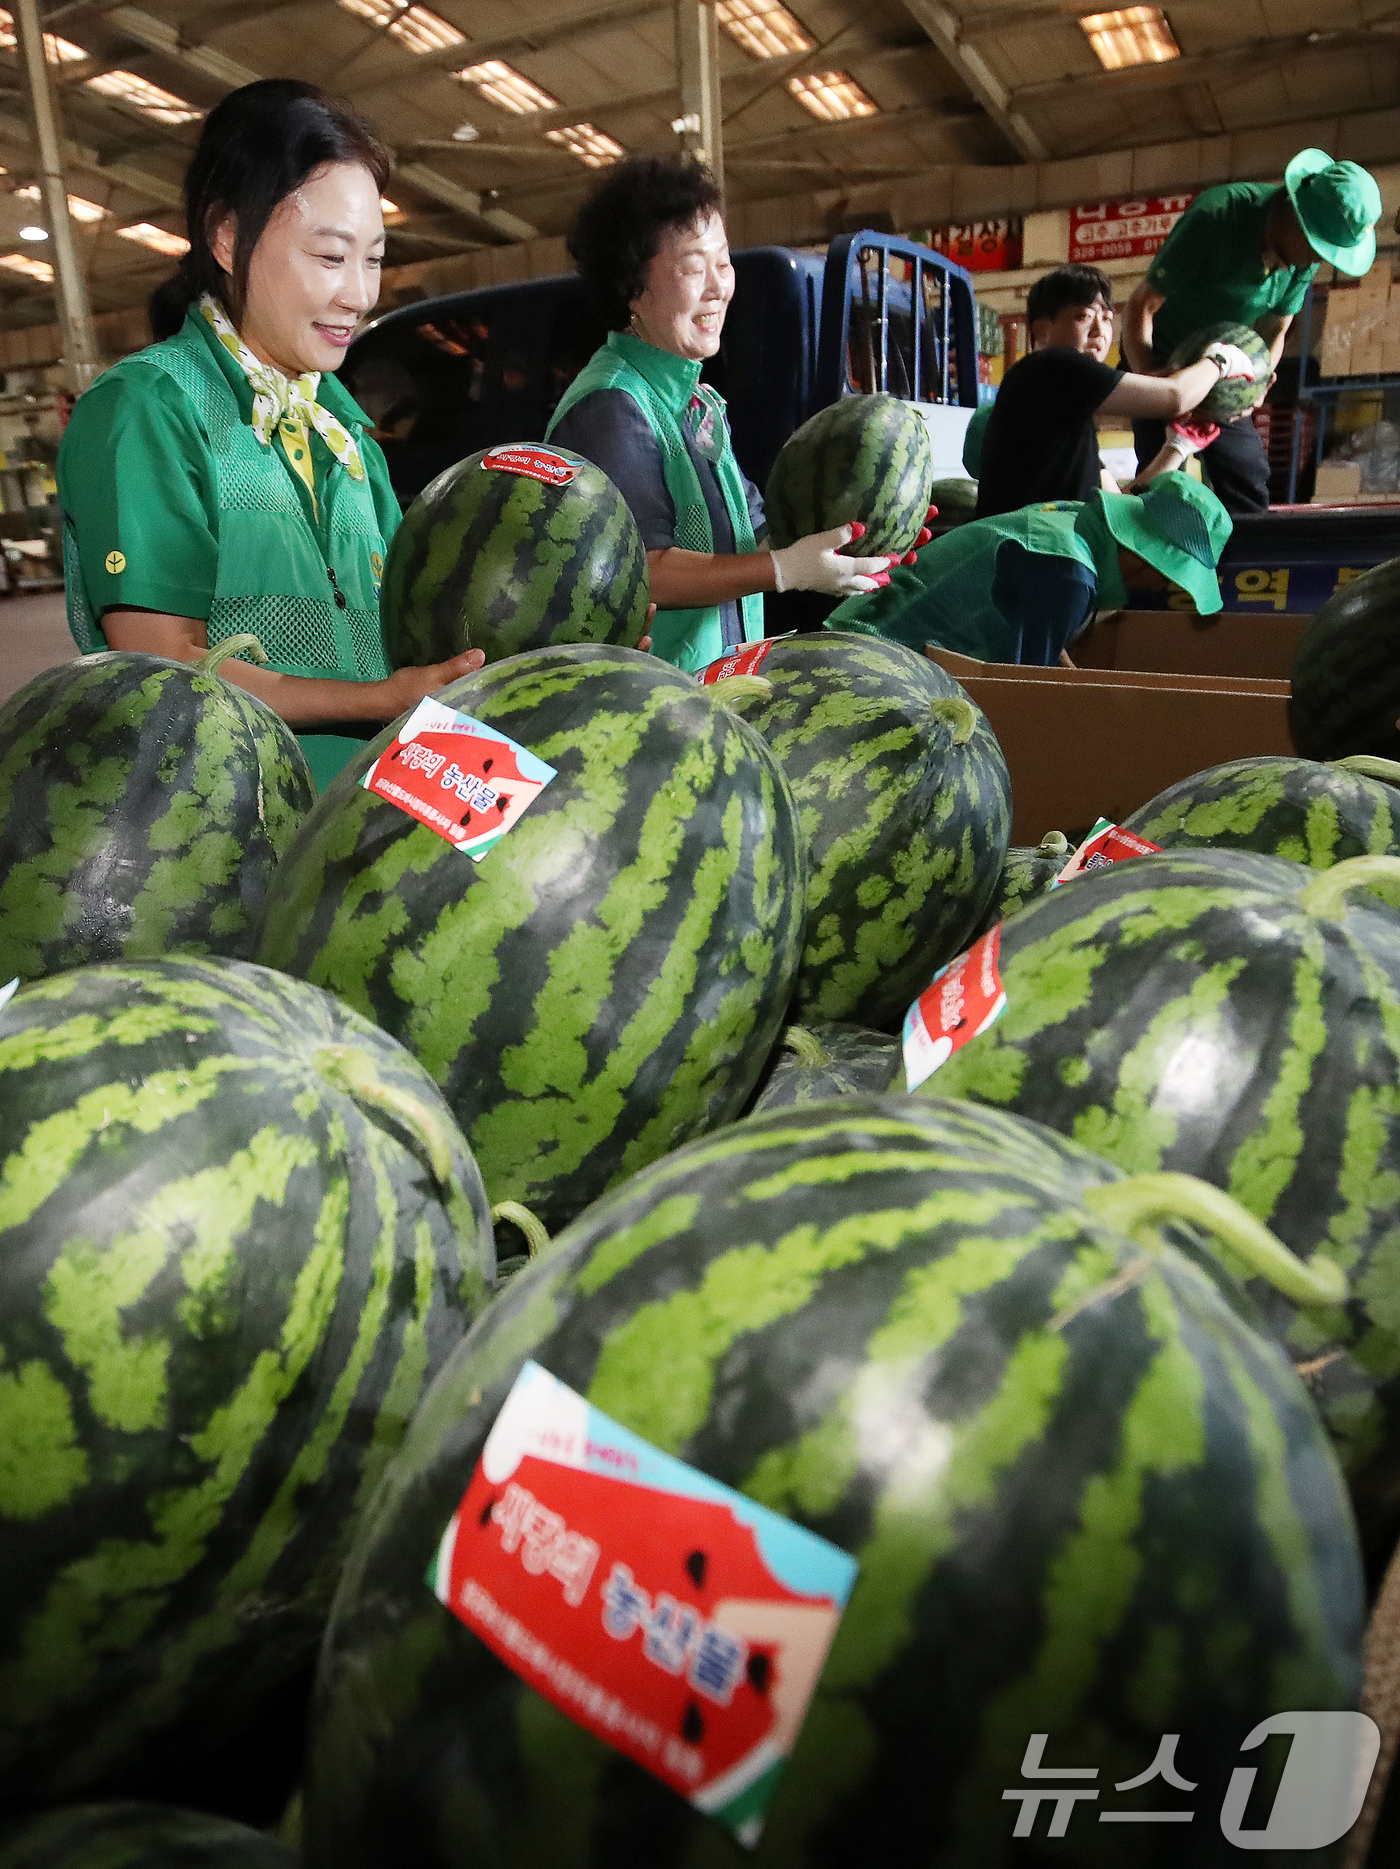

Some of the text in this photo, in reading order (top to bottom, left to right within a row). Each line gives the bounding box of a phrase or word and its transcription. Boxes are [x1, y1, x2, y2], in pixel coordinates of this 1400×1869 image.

[401, 743, 500, 814] 사랑의 농산물
[491, 1482, 600, 1608] 사랑의
[603, 1563, 746, 1706] 농산물
